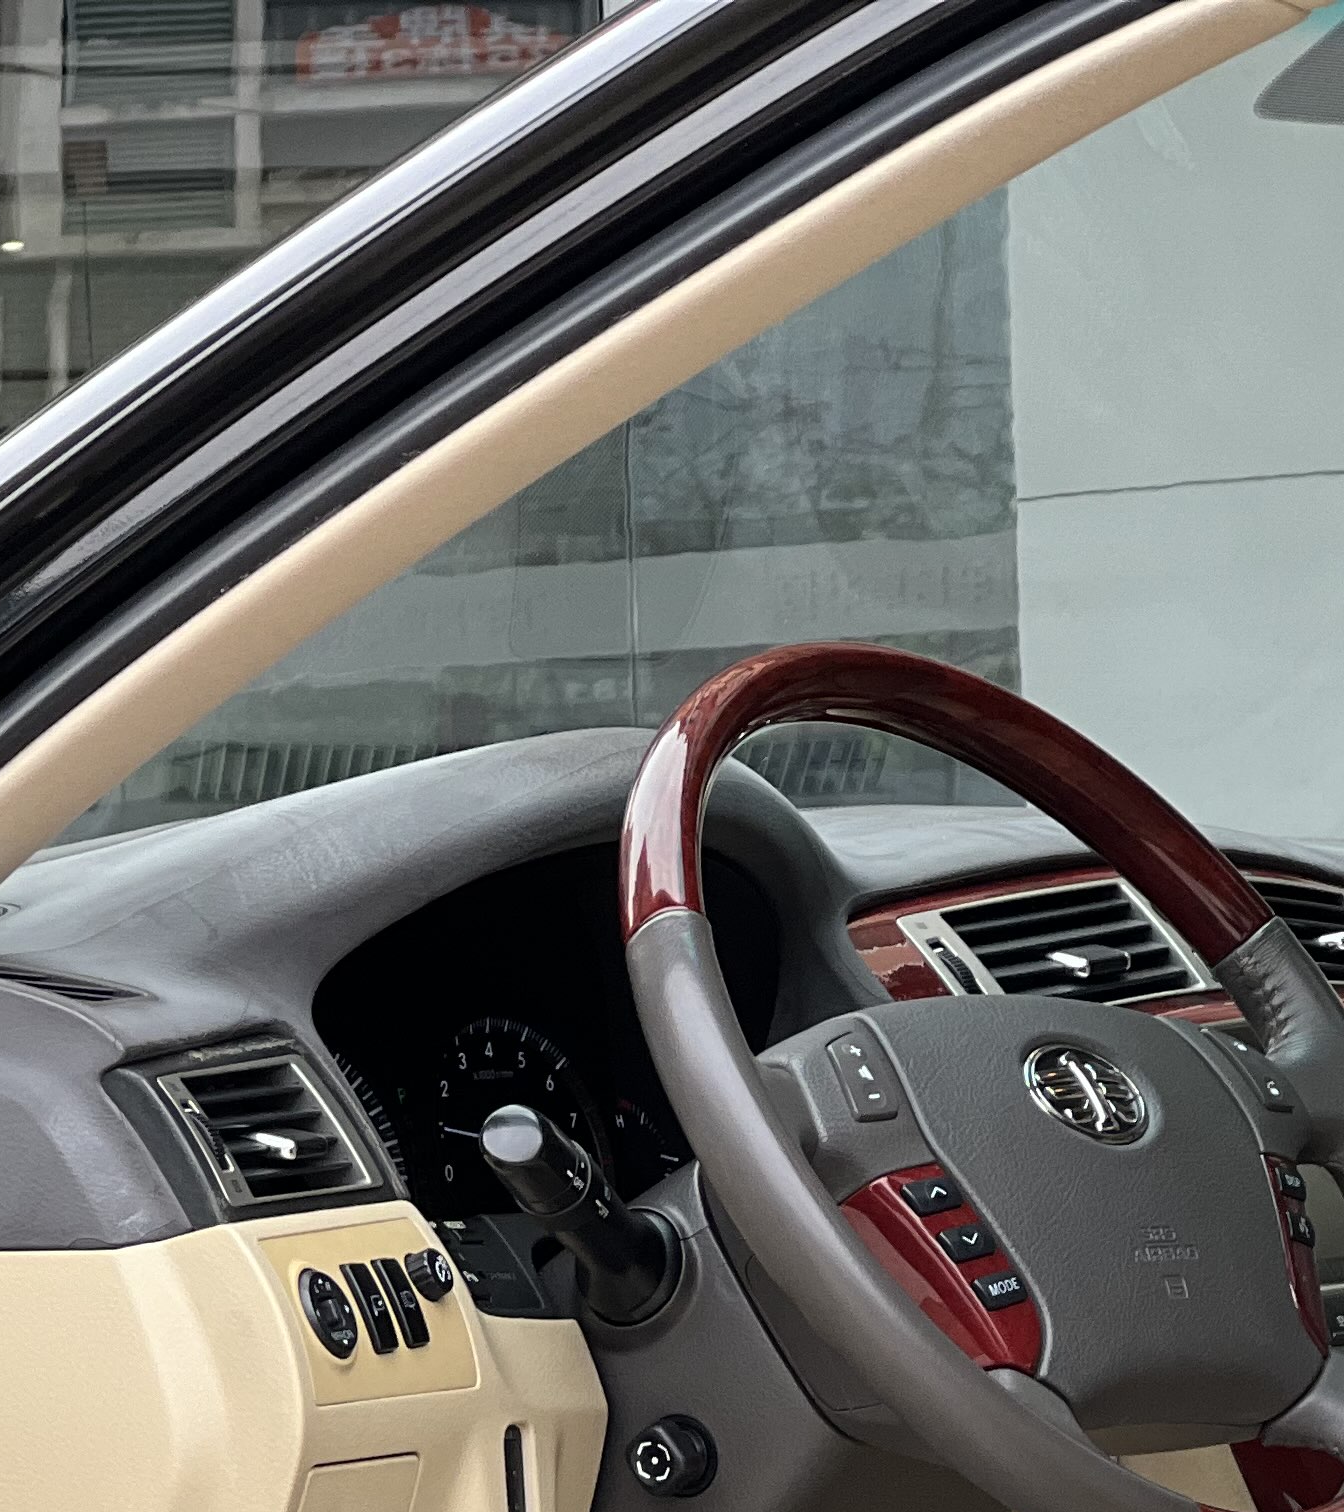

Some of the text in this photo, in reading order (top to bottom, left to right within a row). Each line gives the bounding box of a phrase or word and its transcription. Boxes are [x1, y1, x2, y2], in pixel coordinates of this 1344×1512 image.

[485, 1041, 494, 1058] 4
[458, 1052, 467, 1069] 3
[517, 1052, 526, 1068] 5
[440, 1080, 450, 1097] 2
[546, 1075, 554, 1091] 6
[570, 1113, 577, 1128] 7
[615, 1114, 625, 1129] H
[445, 1165, 453, 1181] 0
[988, 1277, 1020, 1296] MODE
